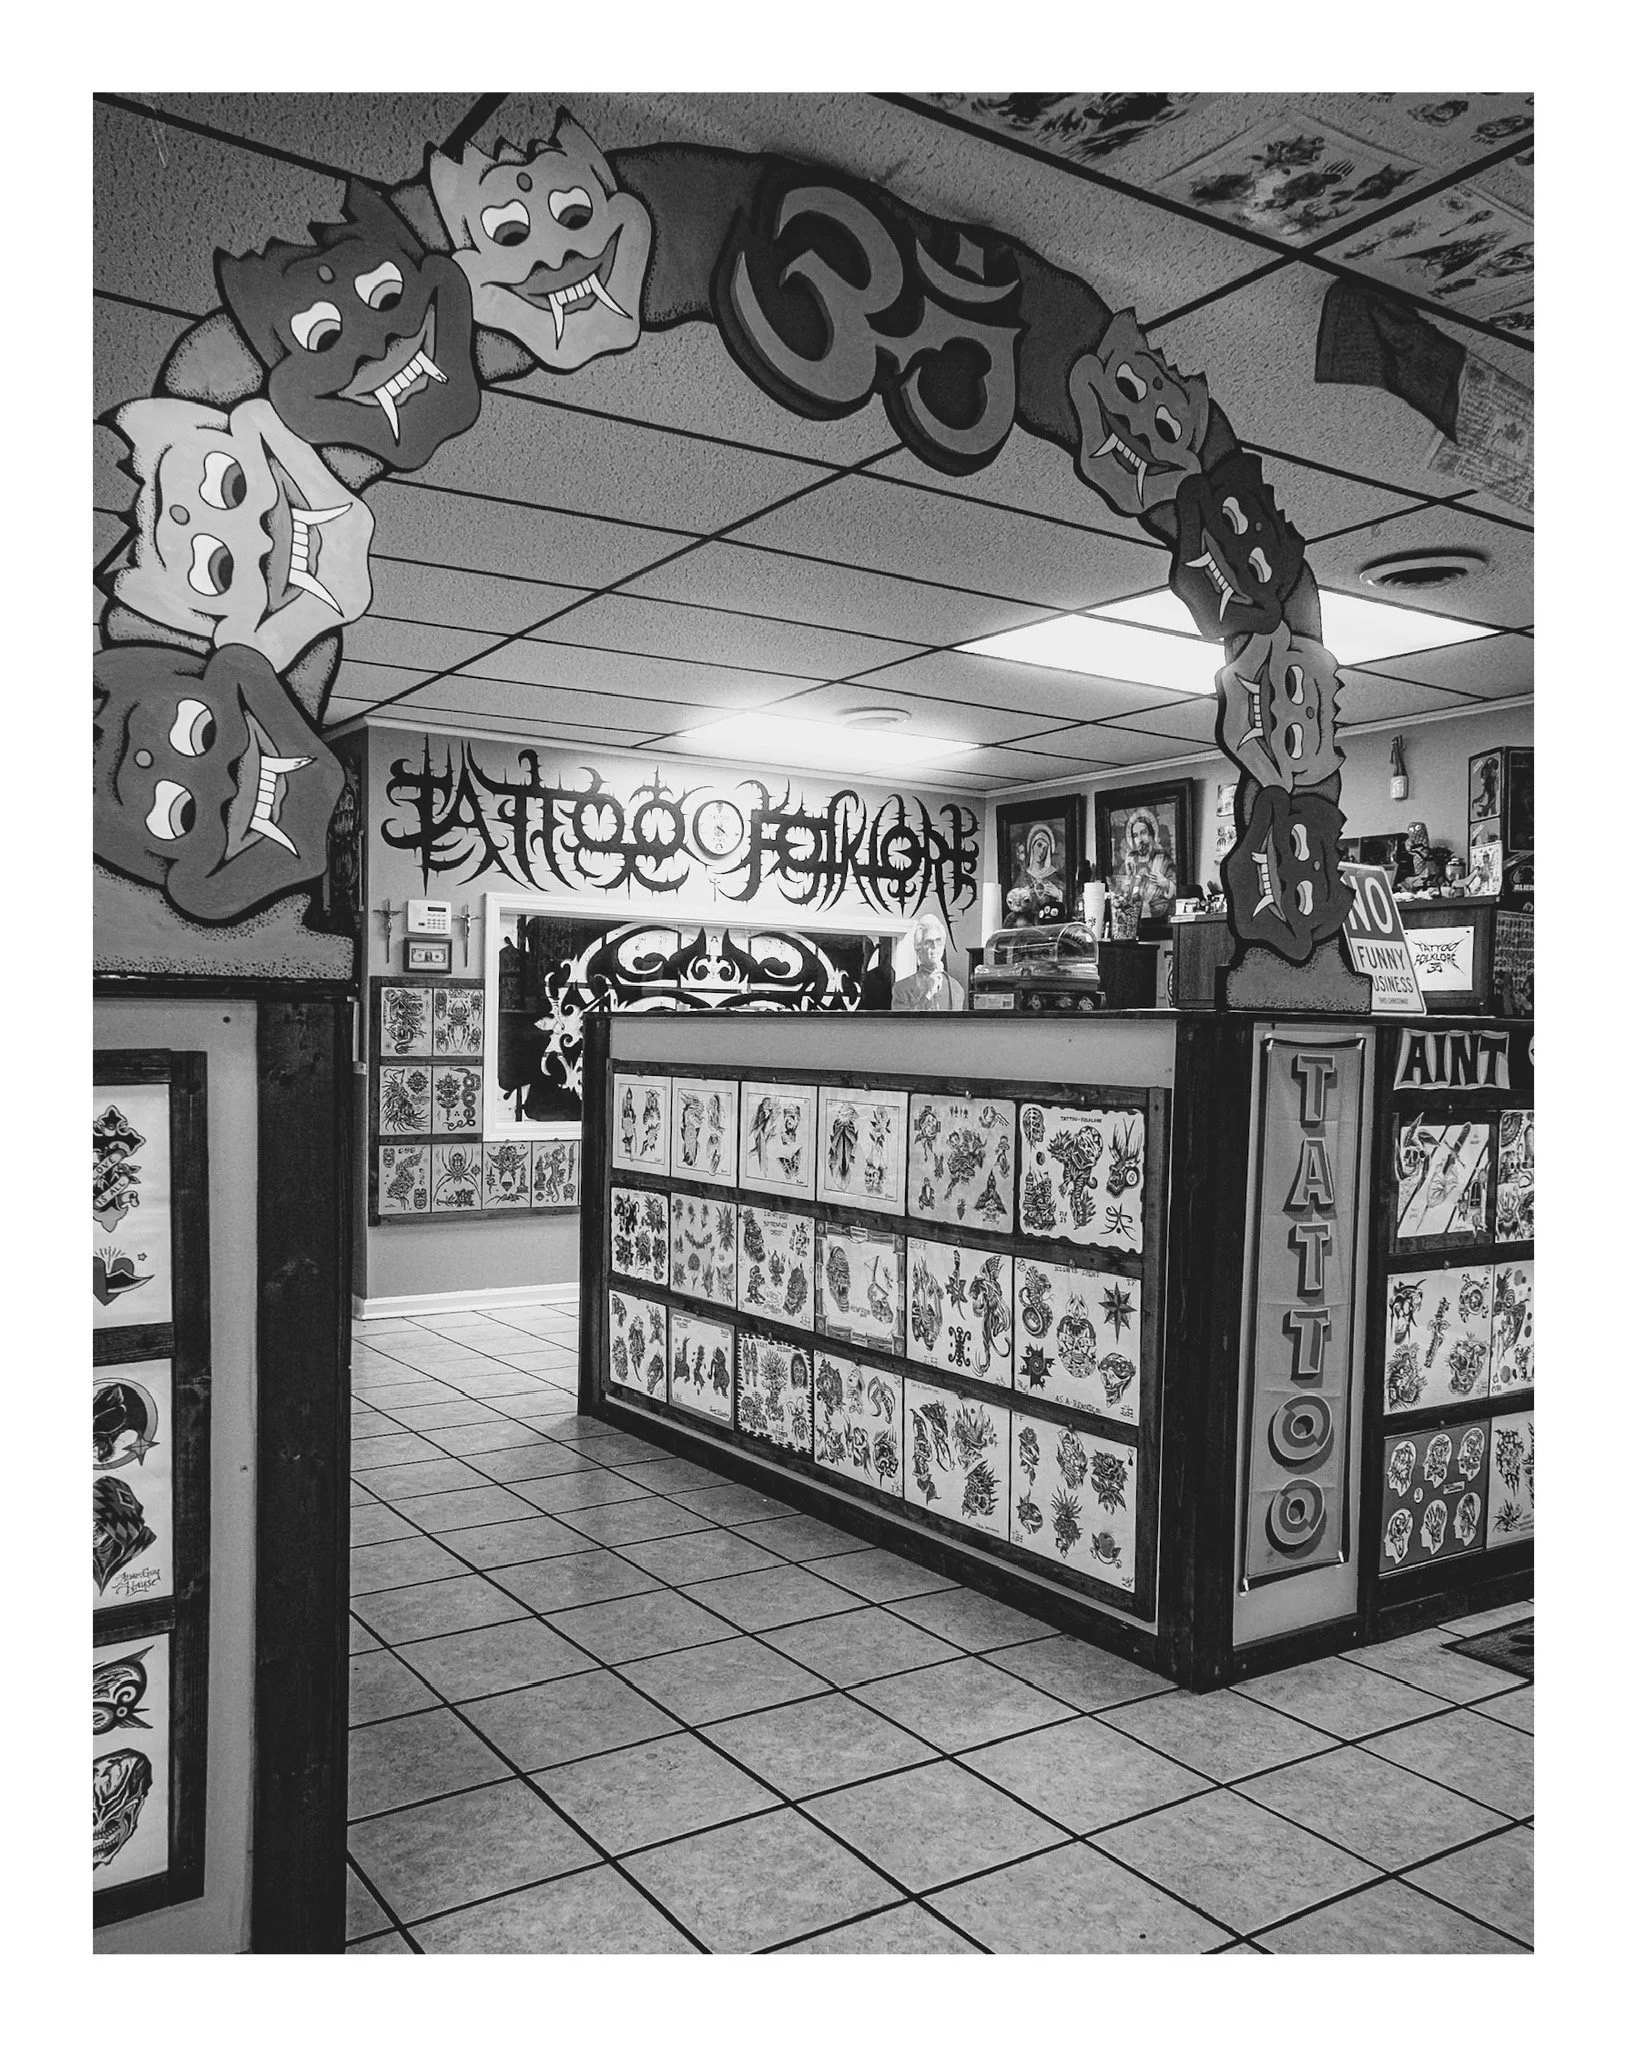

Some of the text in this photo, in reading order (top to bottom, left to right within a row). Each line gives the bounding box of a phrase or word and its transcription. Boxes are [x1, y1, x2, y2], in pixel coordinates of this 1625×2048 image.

[381, 733, 690, 898] TATTOO
[1357, 945, 1406, 971] FUNNY
[1413, 940, 1465, 952] TATTOO
[1371, 975, 1413, 993] USINESS
[1399, 1030, 1510, 1088] AINT
[96, 1181, 127, 1206] IS ALL
[1266, 1054, 1337, 1557] TATTOO
